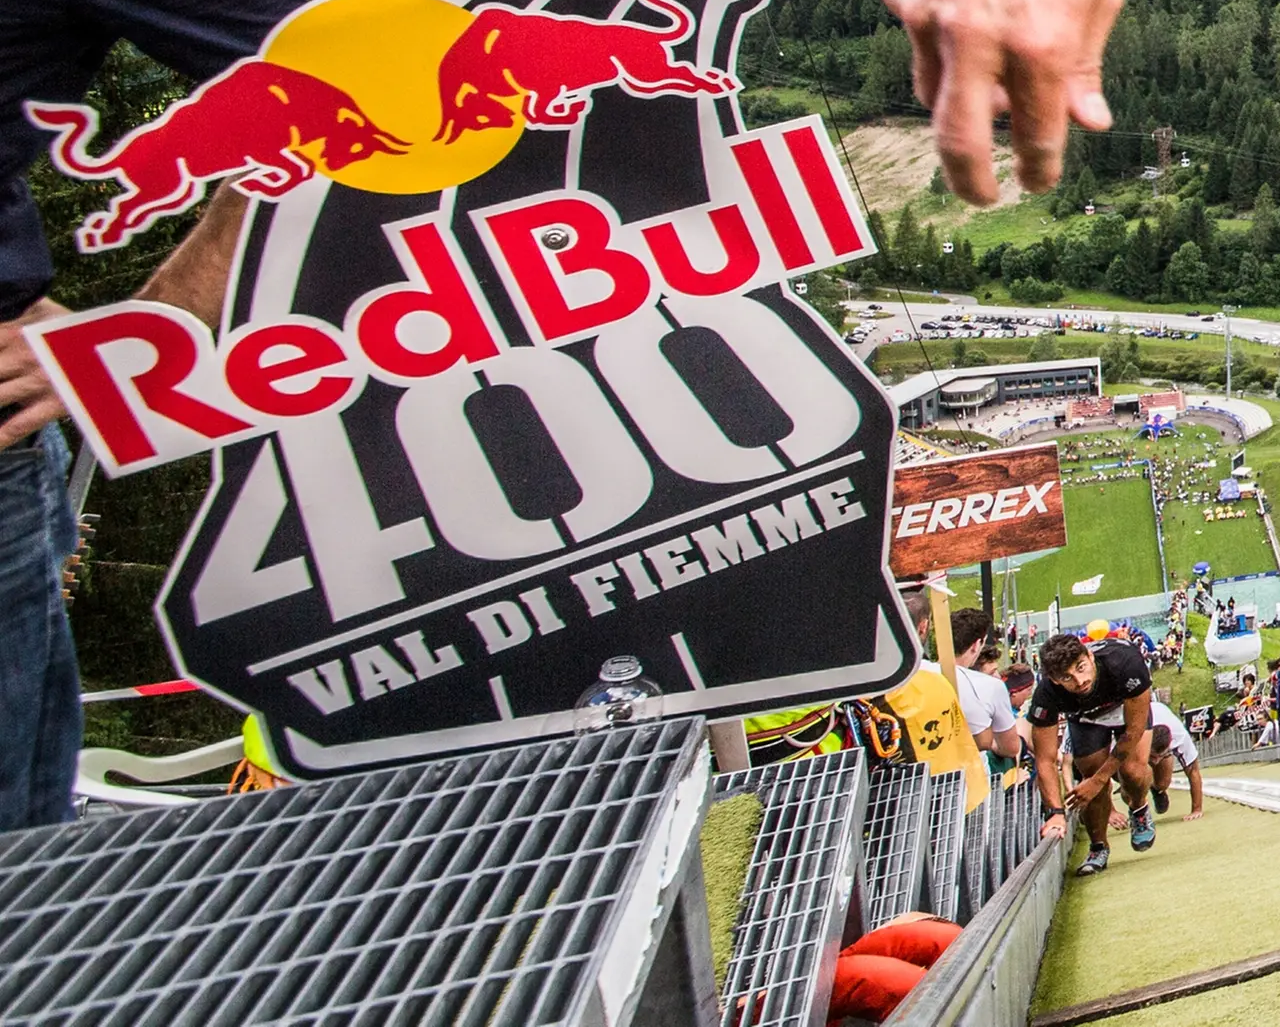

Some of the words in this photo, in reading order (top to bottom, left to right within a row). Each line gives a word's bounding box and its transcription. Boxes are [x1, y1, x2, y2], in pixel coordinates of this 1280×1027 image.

[193, 282, 861, 623] 400
[287, 629, 463, 715] VAL
[466, 585, 567, 656] DI
[569, 476, 867, 617] FIEMME
